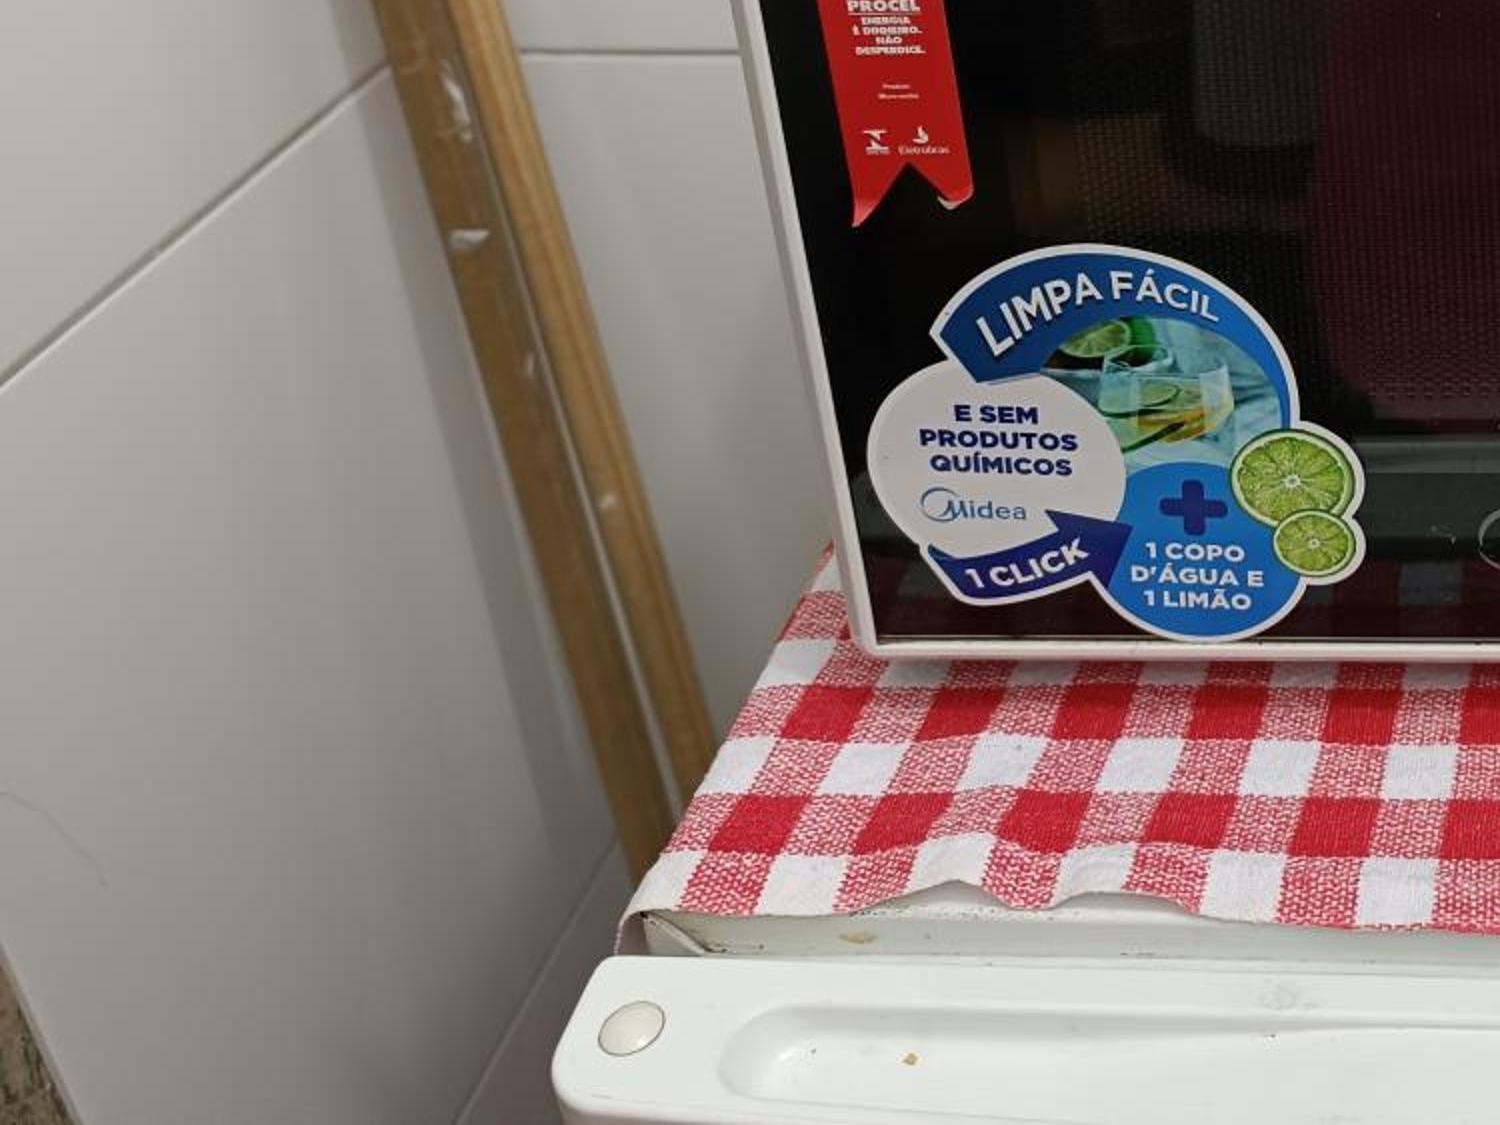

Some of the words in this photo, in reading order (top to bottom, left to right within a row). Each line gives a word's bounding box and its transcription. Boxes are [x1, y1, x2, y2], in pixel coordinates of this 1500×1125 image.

[975, 270, 1103, 357] LIMPA
[1109, 268, 1220, 322] FÁCIL
[953, 404, 972, 422] E
[979, 404, 1039, 425] SEM
[919, 428, 1079, 452] PRODUTOS
[929, 453, 1073, 477] QUÍMICOS
[930, 489, 1027, 522] Midea
[965, 567, 983, 589] 1
[989, 538, 1090, 588] CLICK
[1145, 542, 1157, 560] 1
[1164, 542, 1246, 563] COPO
[1247, 570, 1265, 588] E
[1143, 591, 1156, 607] 1
[1160, 588, 1252, 611] LIMÃO
